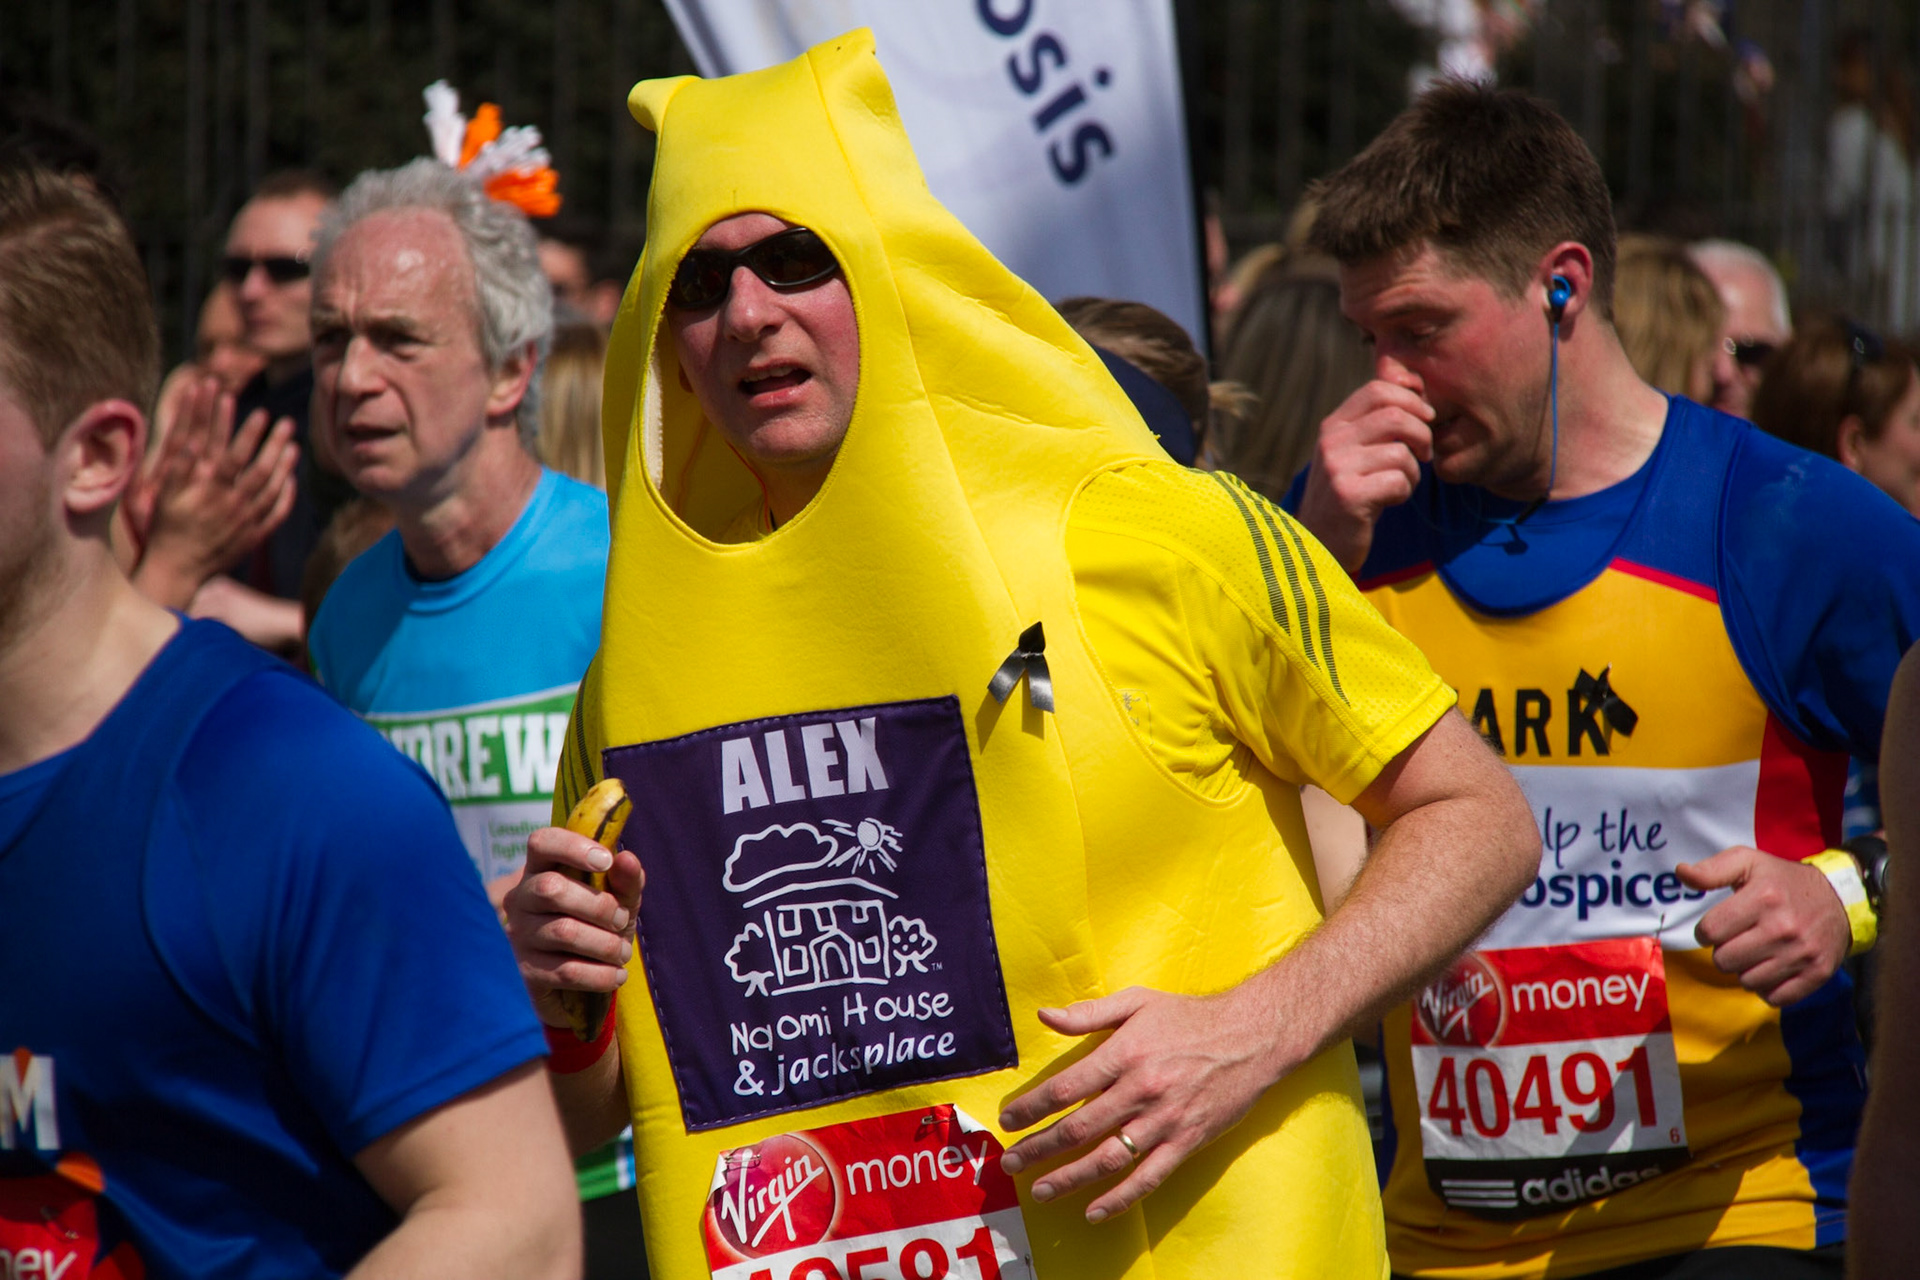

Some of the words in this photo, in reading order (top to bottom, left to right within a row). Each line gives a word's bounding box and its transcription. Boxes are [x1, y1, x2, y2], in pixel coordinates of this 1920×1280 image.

[1454, 688, 1610, 757] ARK
[720, 716, 889, 815] ALEX
[1540, 806, 1581, 870] lp
[1593, 808, 1667, 854] the
[729, 1006, 832, 1056] Naomi
[843, 992, 955, 1028] House
[1421, 969, 1495, 1042] Virgin
[1511, 972, 1650, 1012] money
[733, 1059, 765, 1096] &
[771, 1031, 957, 1096] jacksplace
[1427, 1046, 1658, 1139] 40491
[1669, 1127, 1680, 1144] 6
[721, 1149, 824, 1248] Virgin
[845, 1140, 988, 1196] money
